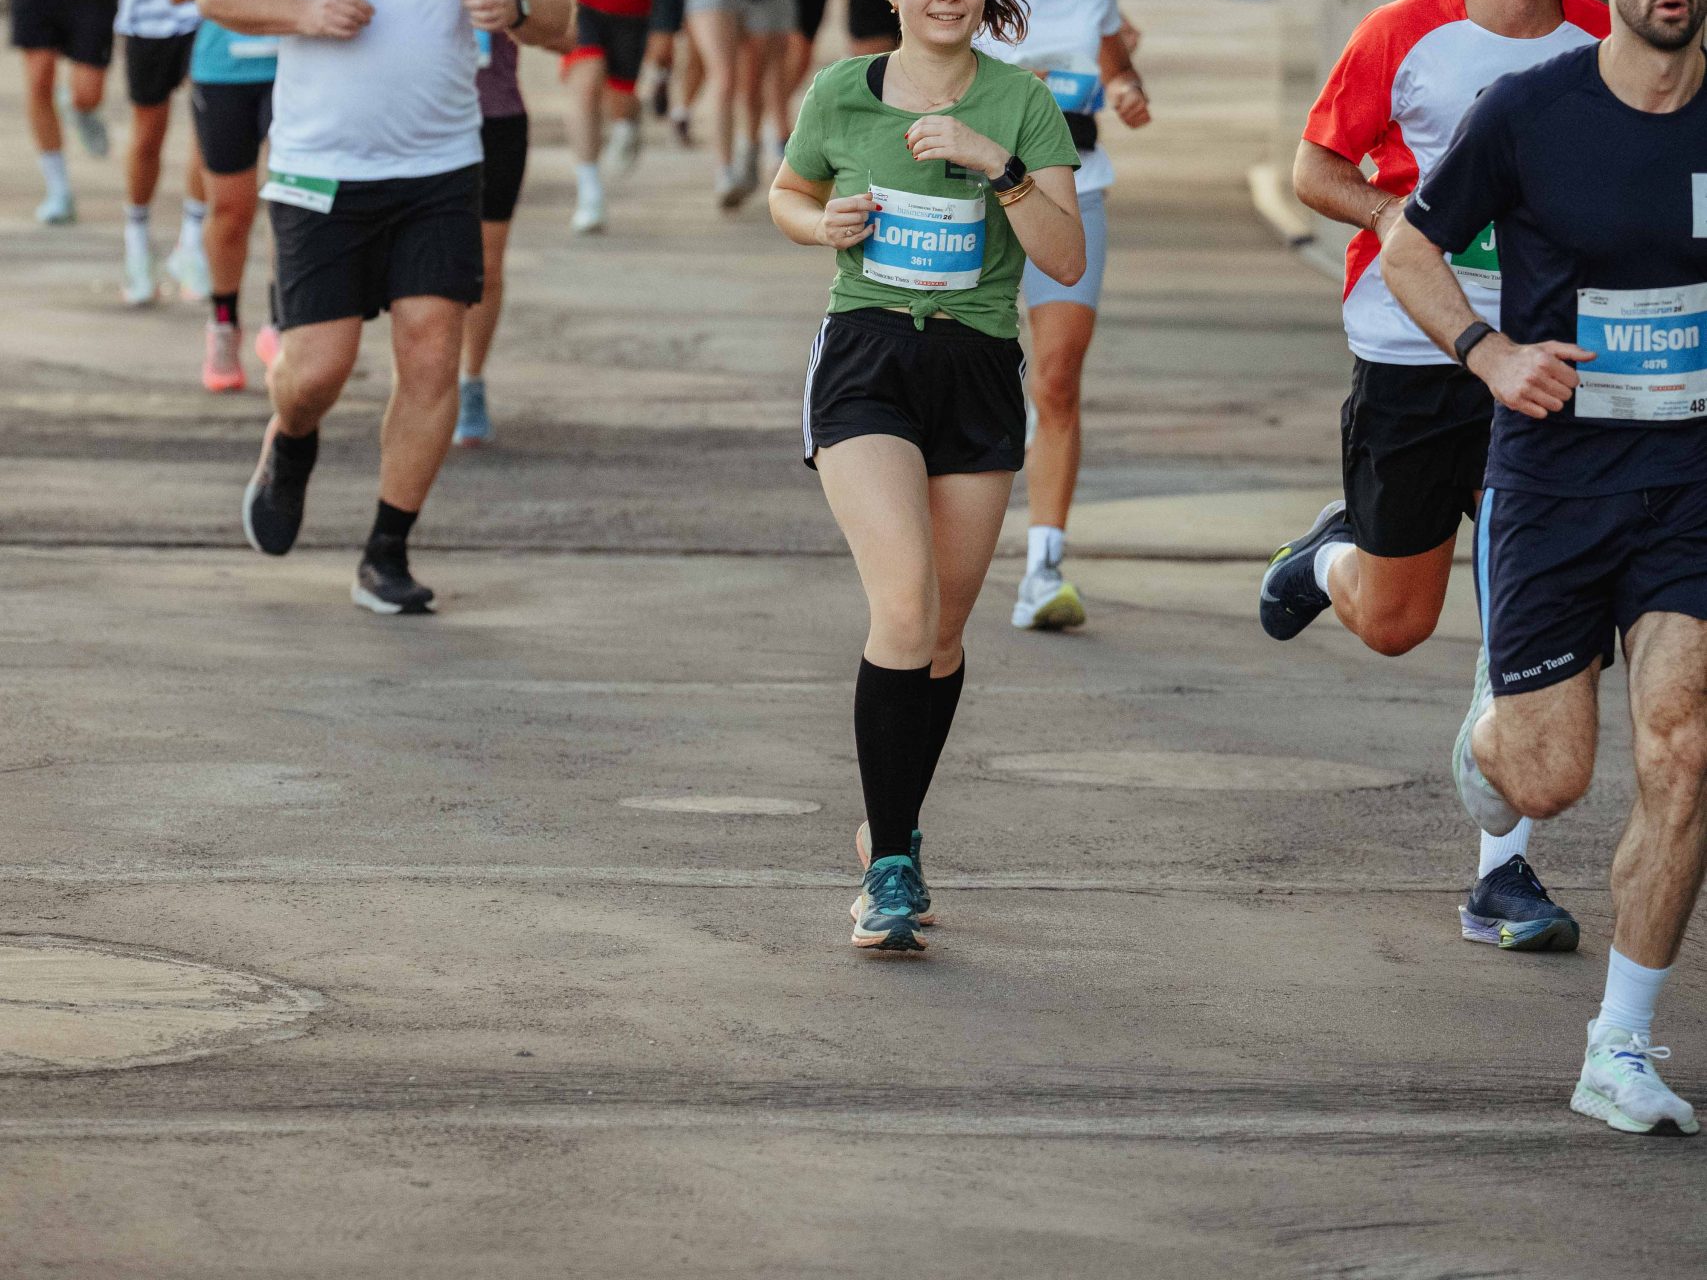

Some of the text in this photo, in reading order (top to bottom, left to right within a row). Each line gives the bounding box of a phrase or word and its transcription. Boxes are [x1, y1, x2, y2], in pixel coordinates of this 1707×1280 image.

[874, 217, 976, 252] Lorraine
[910, 256, 932, 267] 3611
[1604, 324, 1699, 352] Wilson
[1642, 358, 1668, 369] 4876
[1689, 398, 1707, 413] 48
[1502, 652, 1575, 685] Join our Team
